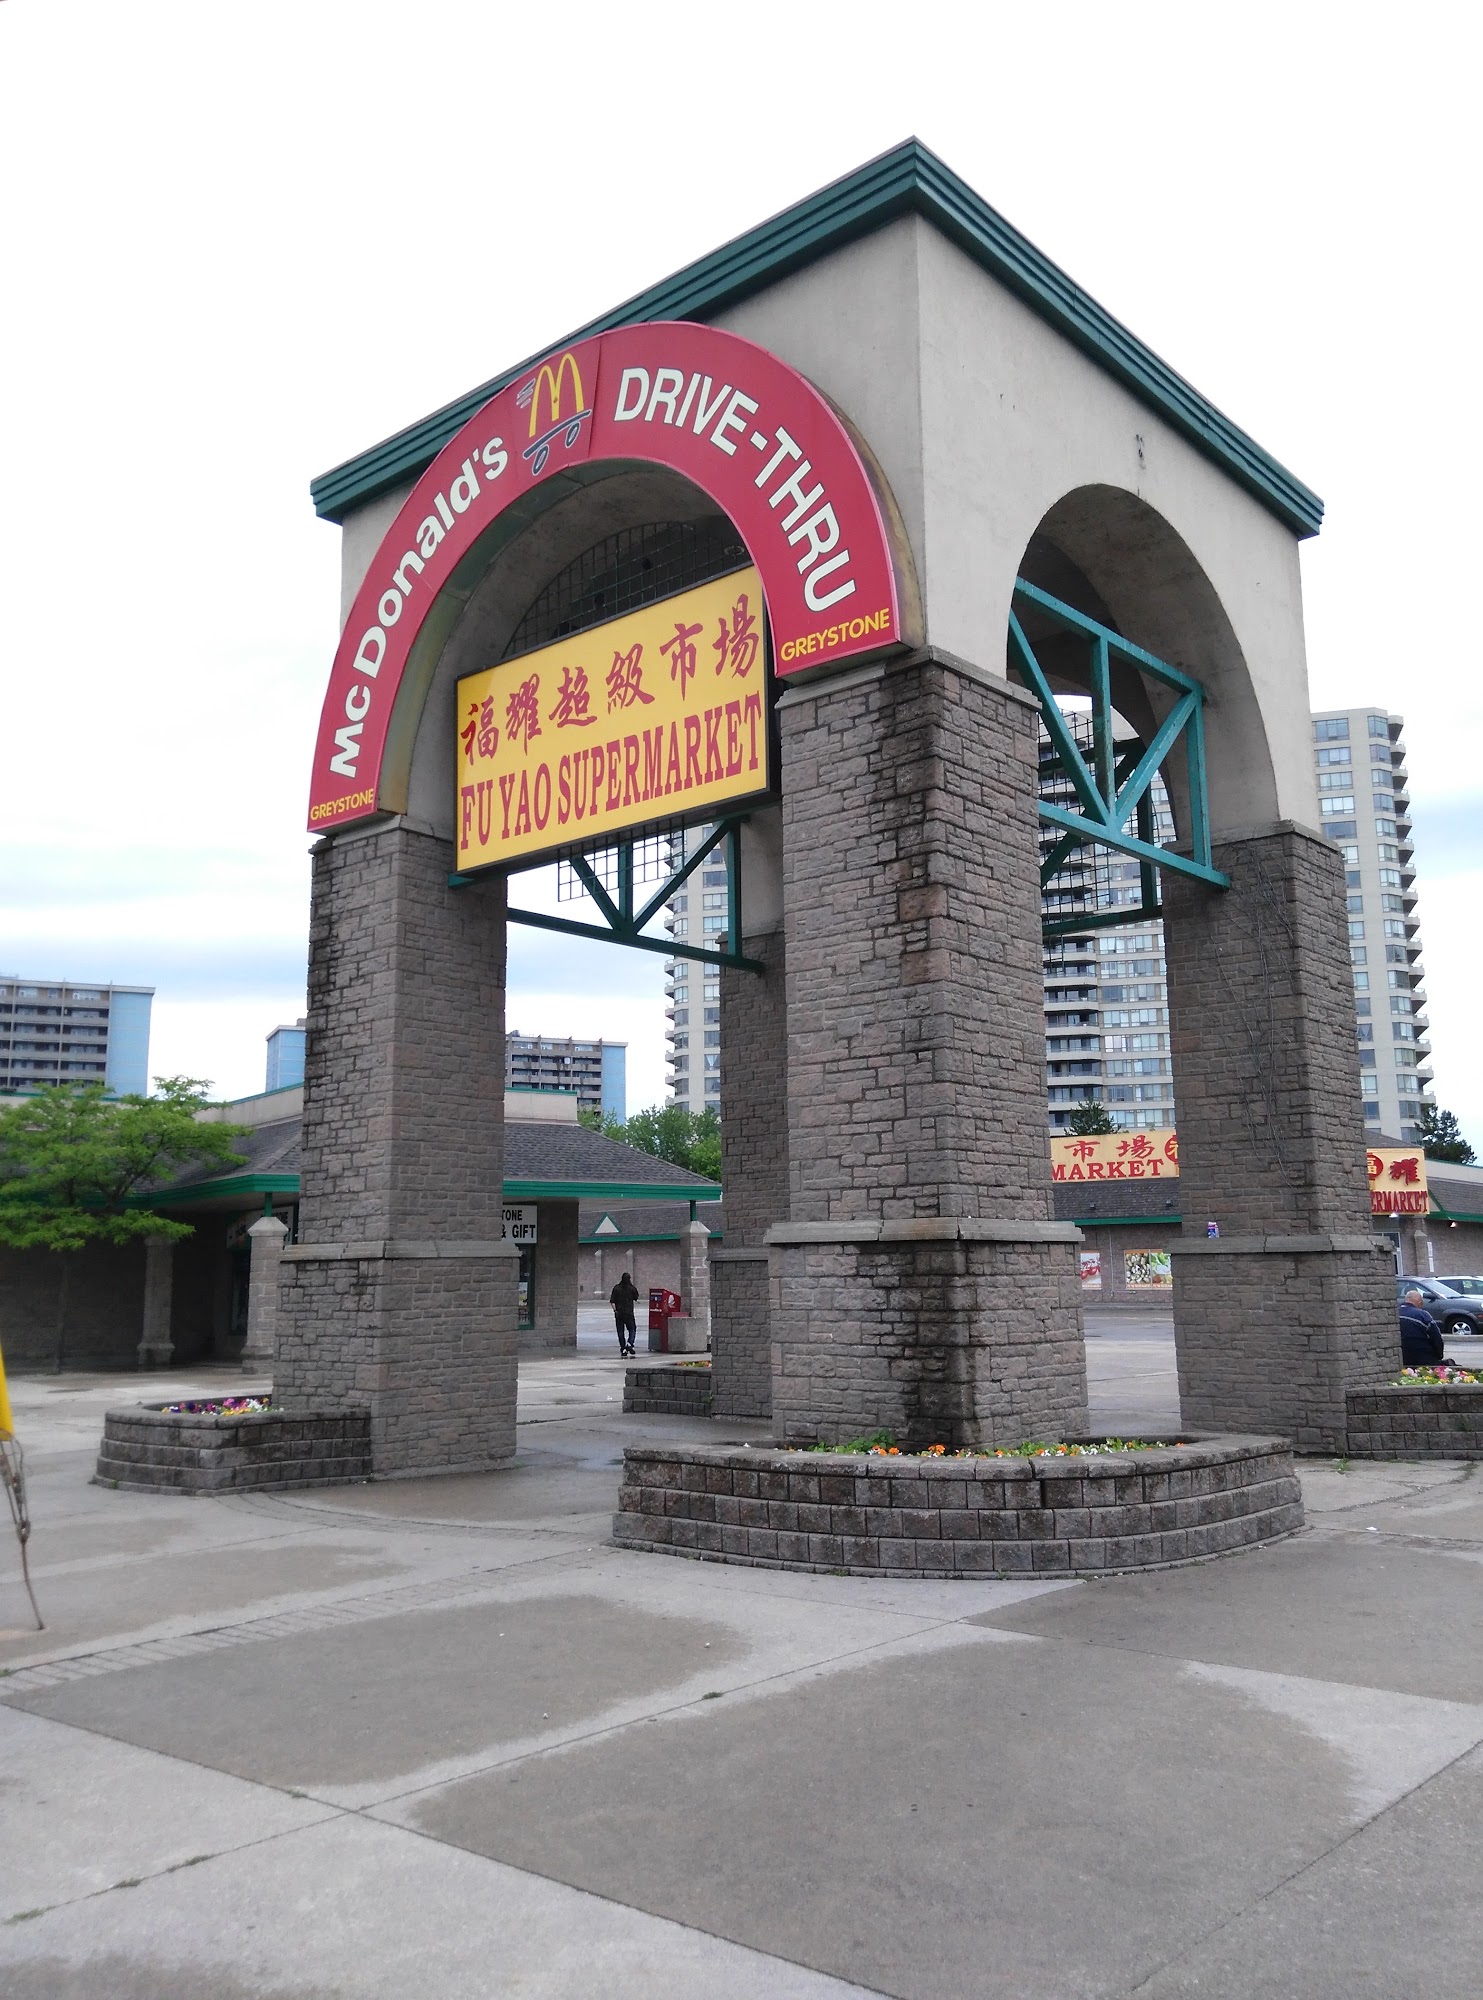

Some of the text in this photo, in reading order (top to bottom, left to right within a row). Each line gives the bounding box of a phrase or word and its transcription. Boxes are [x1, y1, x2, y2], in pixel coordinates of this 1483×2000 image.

[613, 366, 857, 613] DRIVE-THRU
[329, 436, 508, 779] McDonald's
[780, 607, 892, 662] GREYSTONE
[460, 593, 760, 766] 福耀超級市場
[310, 788, 374, 821] GREYSTONE
[460, 690, 762, 851] FU YAO SUPERMARKET
[1063, 1134, 1156, 1164] 市場
[512, 1223, 536, 1239] GIFT
